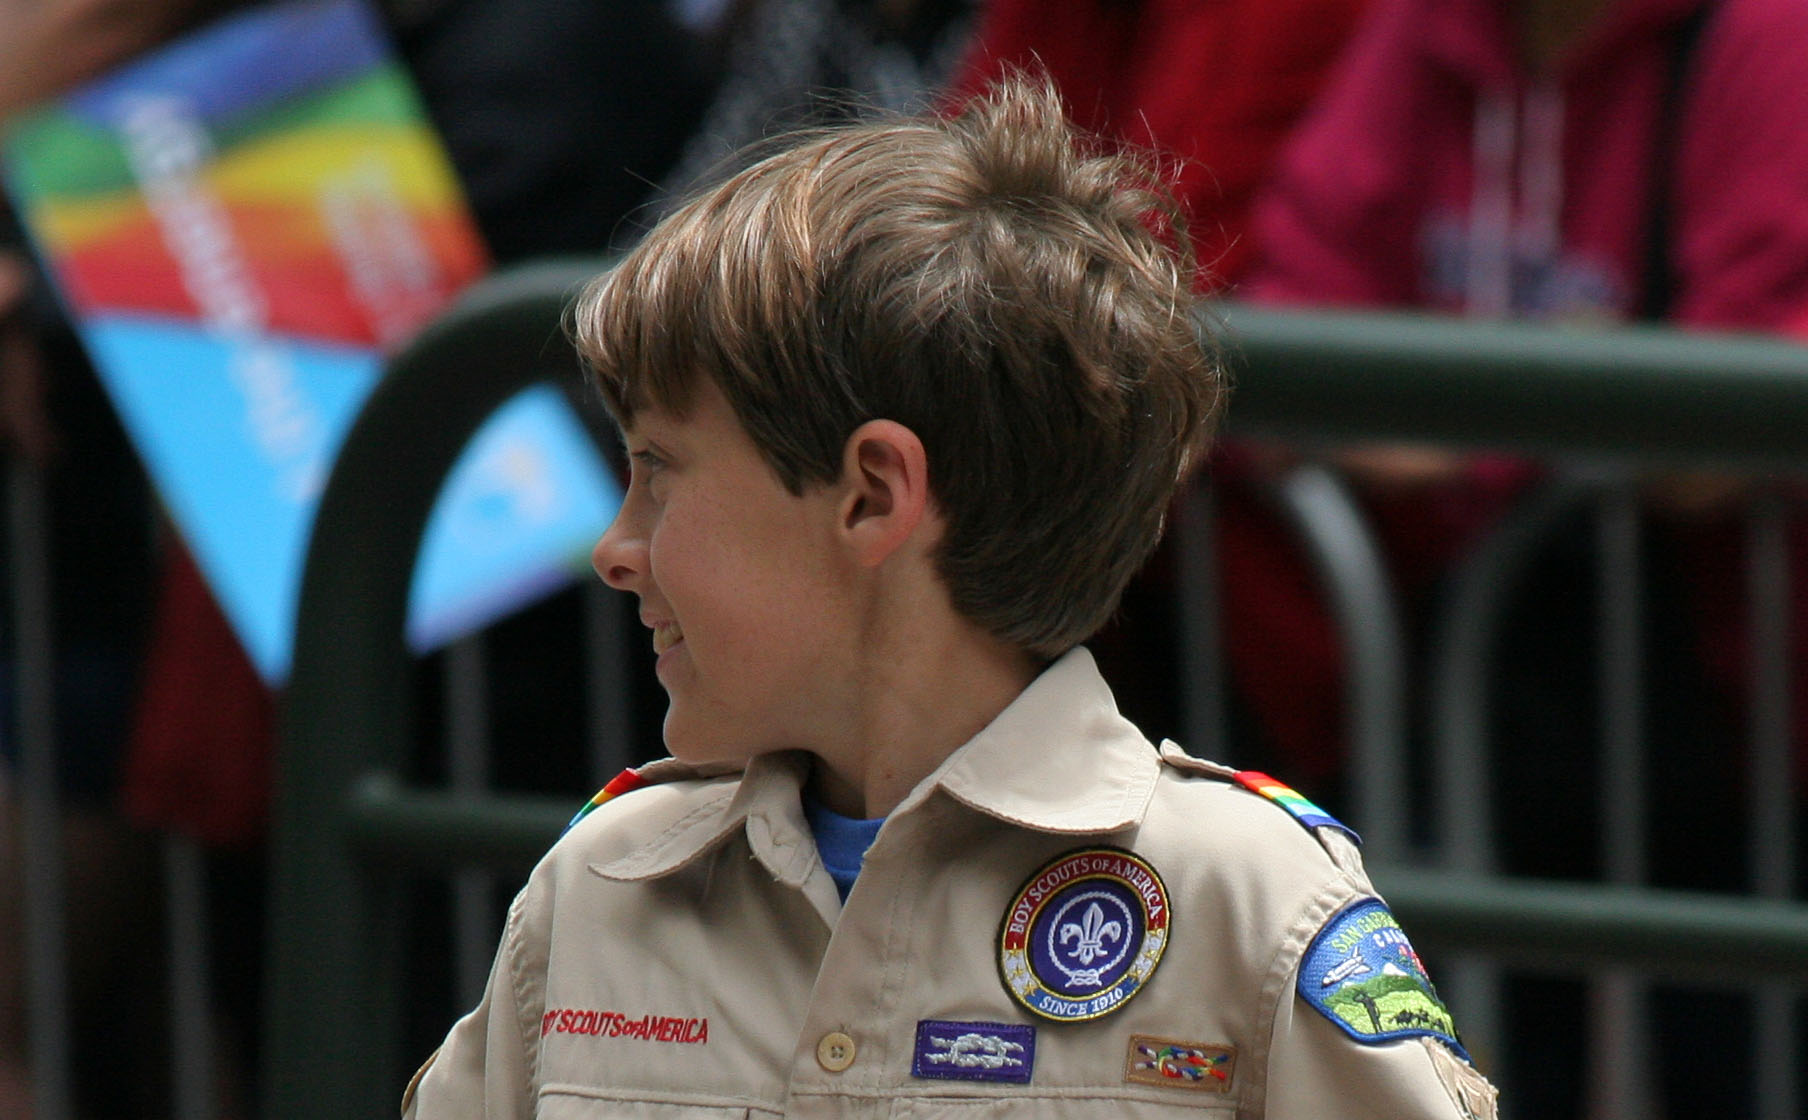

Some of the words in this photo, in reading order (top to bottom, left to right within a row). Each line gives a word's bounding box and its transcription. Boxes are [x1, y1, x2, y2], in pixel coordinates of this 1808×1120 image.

[1009, 898, 1034, 934] BOY
[1029, 857, 1090, 902] SCOUTS
[1092, 858, 1111, 872] OF
[1111, 859, 1163, 920] AMERICA
[1039, 996, 1087, 1015] SINCE
[1091, 987, 1124, 1013] 1910
[556, 1009, 625, 1037] SCOUTS
[634, 1015, 708, 1045] AMERICA
